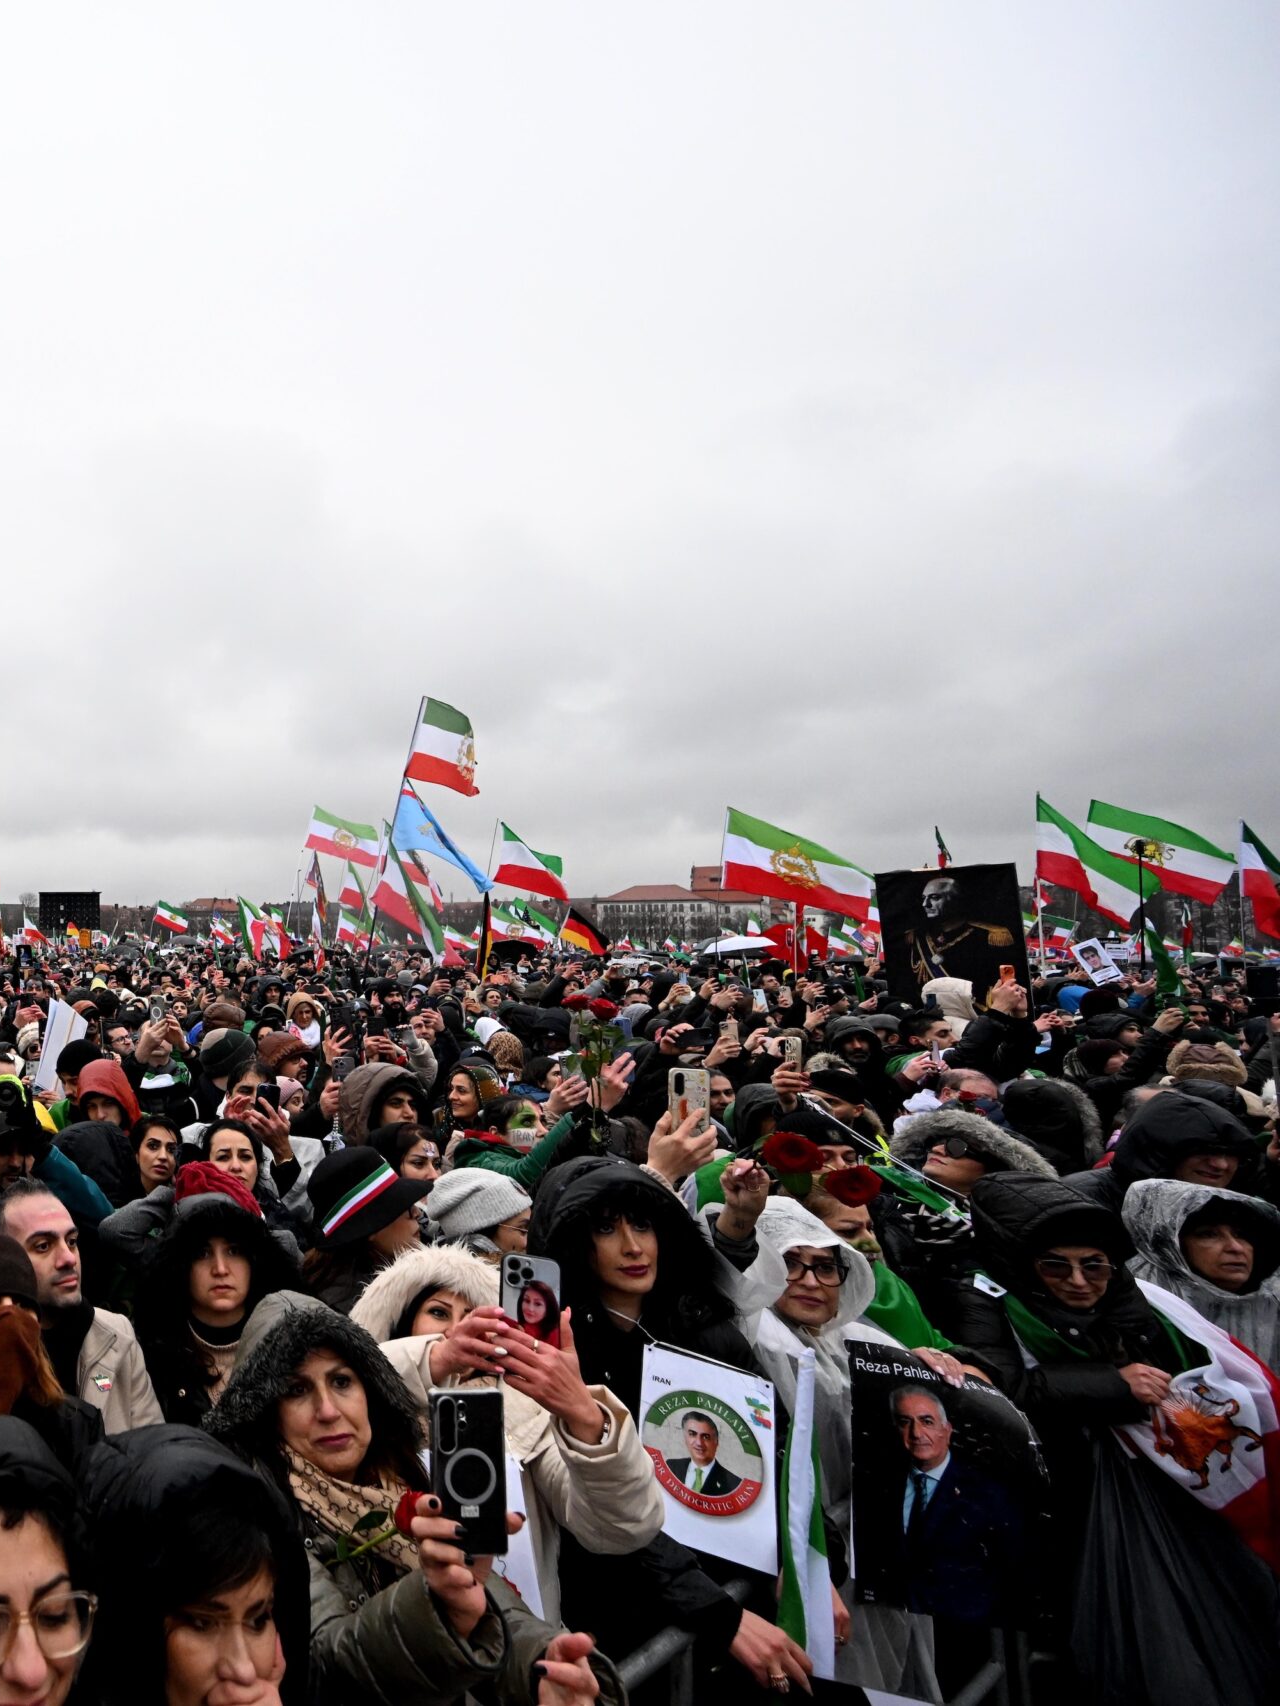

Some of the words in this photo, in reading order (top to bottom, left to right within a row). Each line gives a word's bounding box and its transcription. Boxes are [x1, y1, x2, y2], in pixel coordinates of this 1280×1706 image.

[512, 1130, 535, 1144] IRAN
[855, 1357, 890, 1375] Reza
[652, 1375, 671, 1386] IRAN
[658, 1396, 689, 1416] REZA
[697, 1396, 750, 1440] PAHLAVI
[650, 1453, 665, 1476] FOR
[666, 1478, 734, 1512] DEMOCRATIC
[735, 1483, 755, 1506] IRAN
